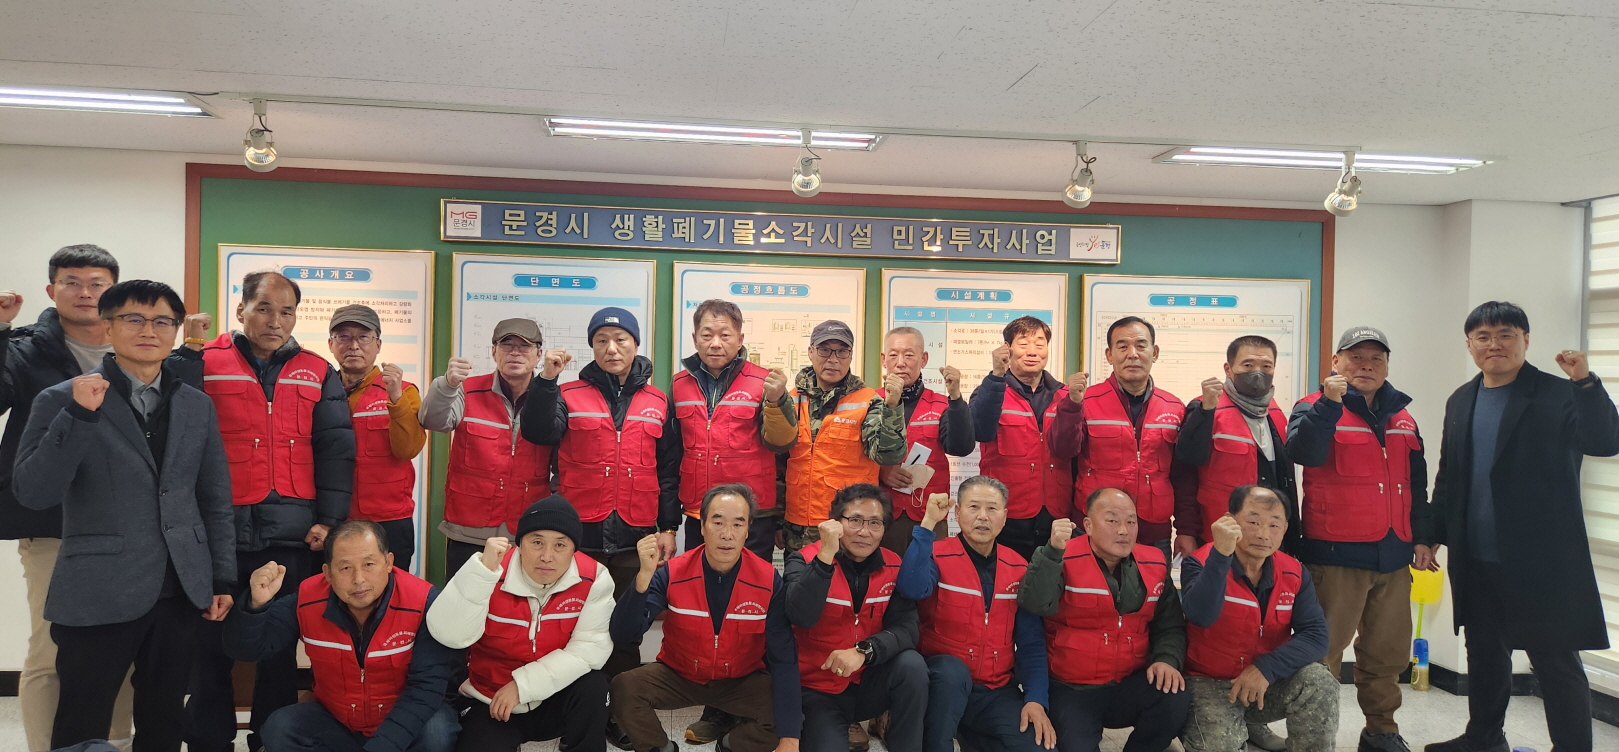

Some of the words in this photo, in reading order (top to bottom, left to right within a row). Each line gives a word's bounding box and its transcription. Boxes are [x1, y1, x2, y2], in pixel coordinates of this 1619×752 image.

[450, 210, 478, 220] MG
[453, 218, 475, 228] 문경시
[501, 209, 590, 239] 문경시
[610, 213, 873, 249] 생활폐기물소각시설
[891, 224, 1057, 255] 민간투자사업
[299, 268, 355, 280] 공사개요
[531, 276, 581, 287] 단면도
[740, 284, 799, 295] 공정흐름도
[950, 290, 998, 301] 시설계획
[1167, 296, 1219, 306] 공정표
